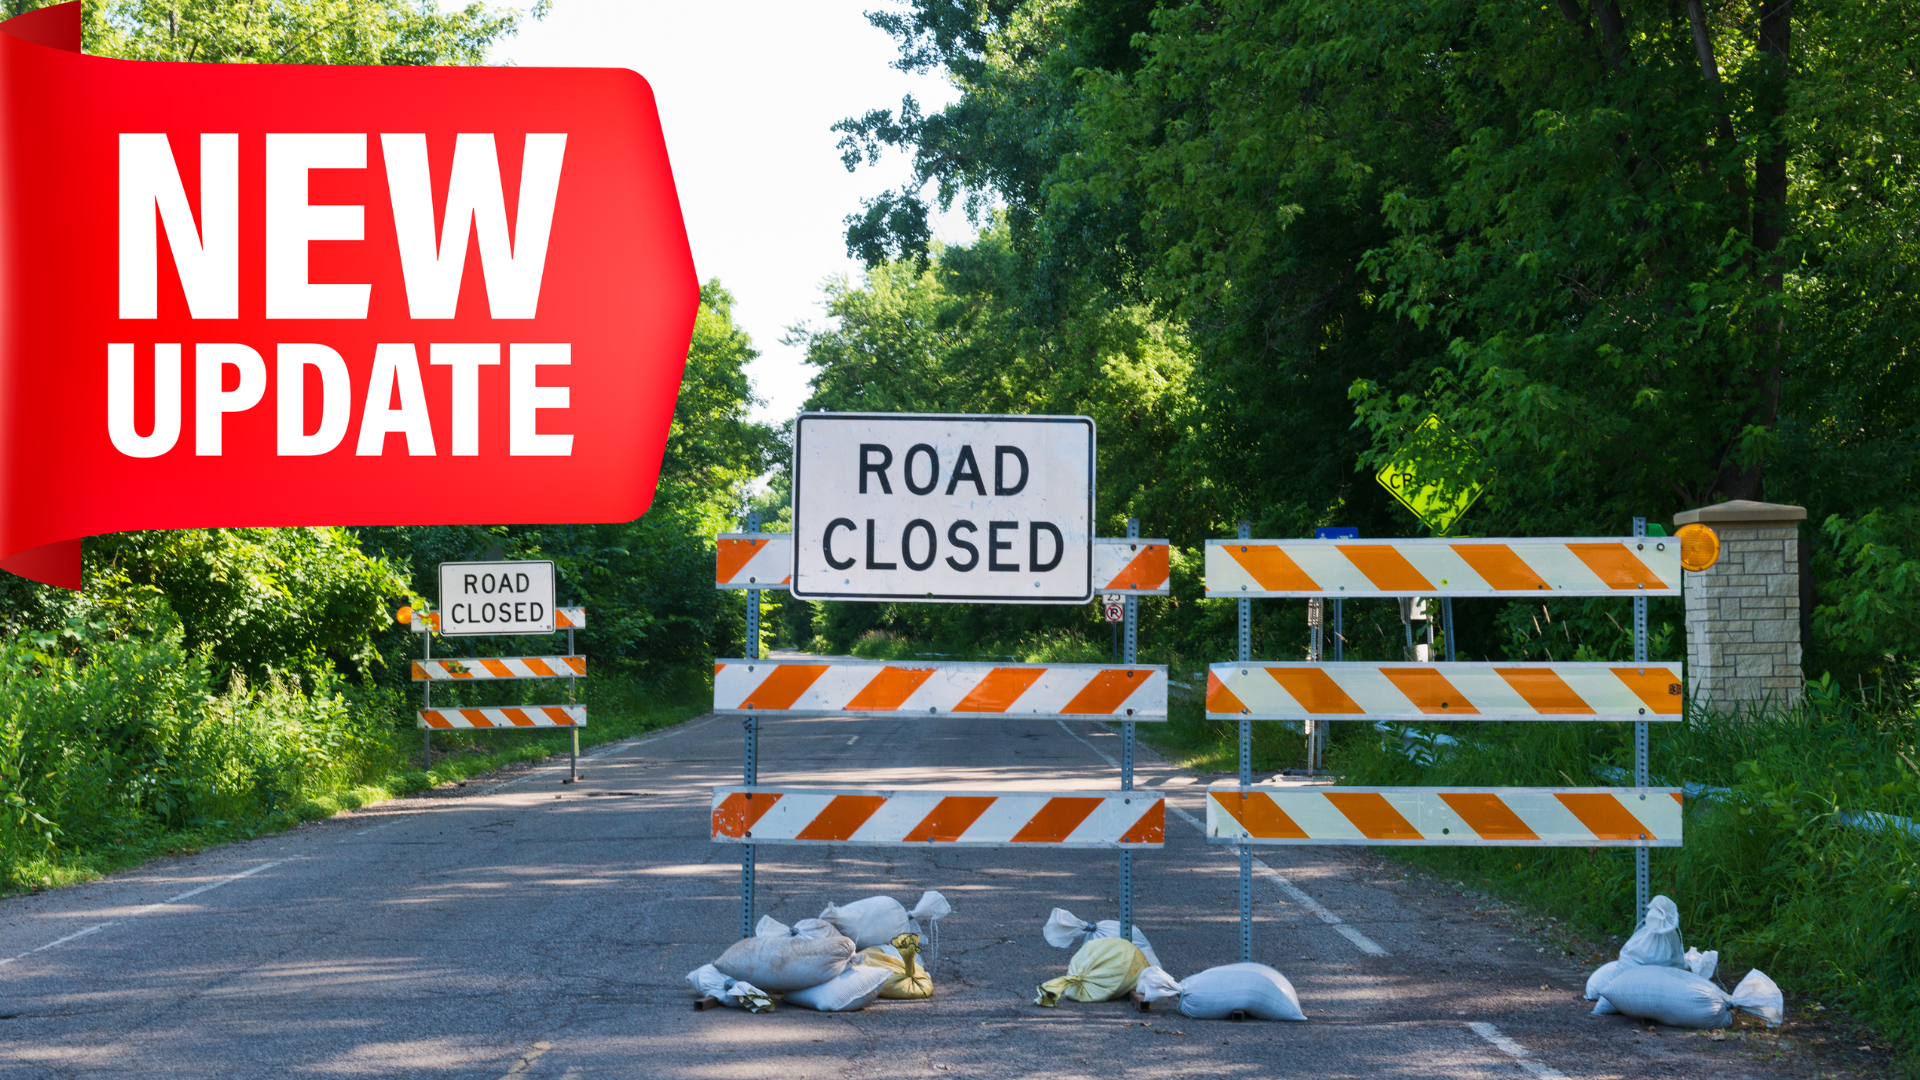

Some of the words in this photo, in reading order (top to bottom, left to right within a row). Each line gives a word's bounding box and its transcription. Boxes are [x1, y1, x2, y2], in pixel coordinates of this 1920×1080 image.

[858, 443, 1030, 496] ROAD
[822, 517, 1065, 573] CLOSED
[464, 573, 530, 594] ROAD
[451, 602, 544, 624] CLOSED
